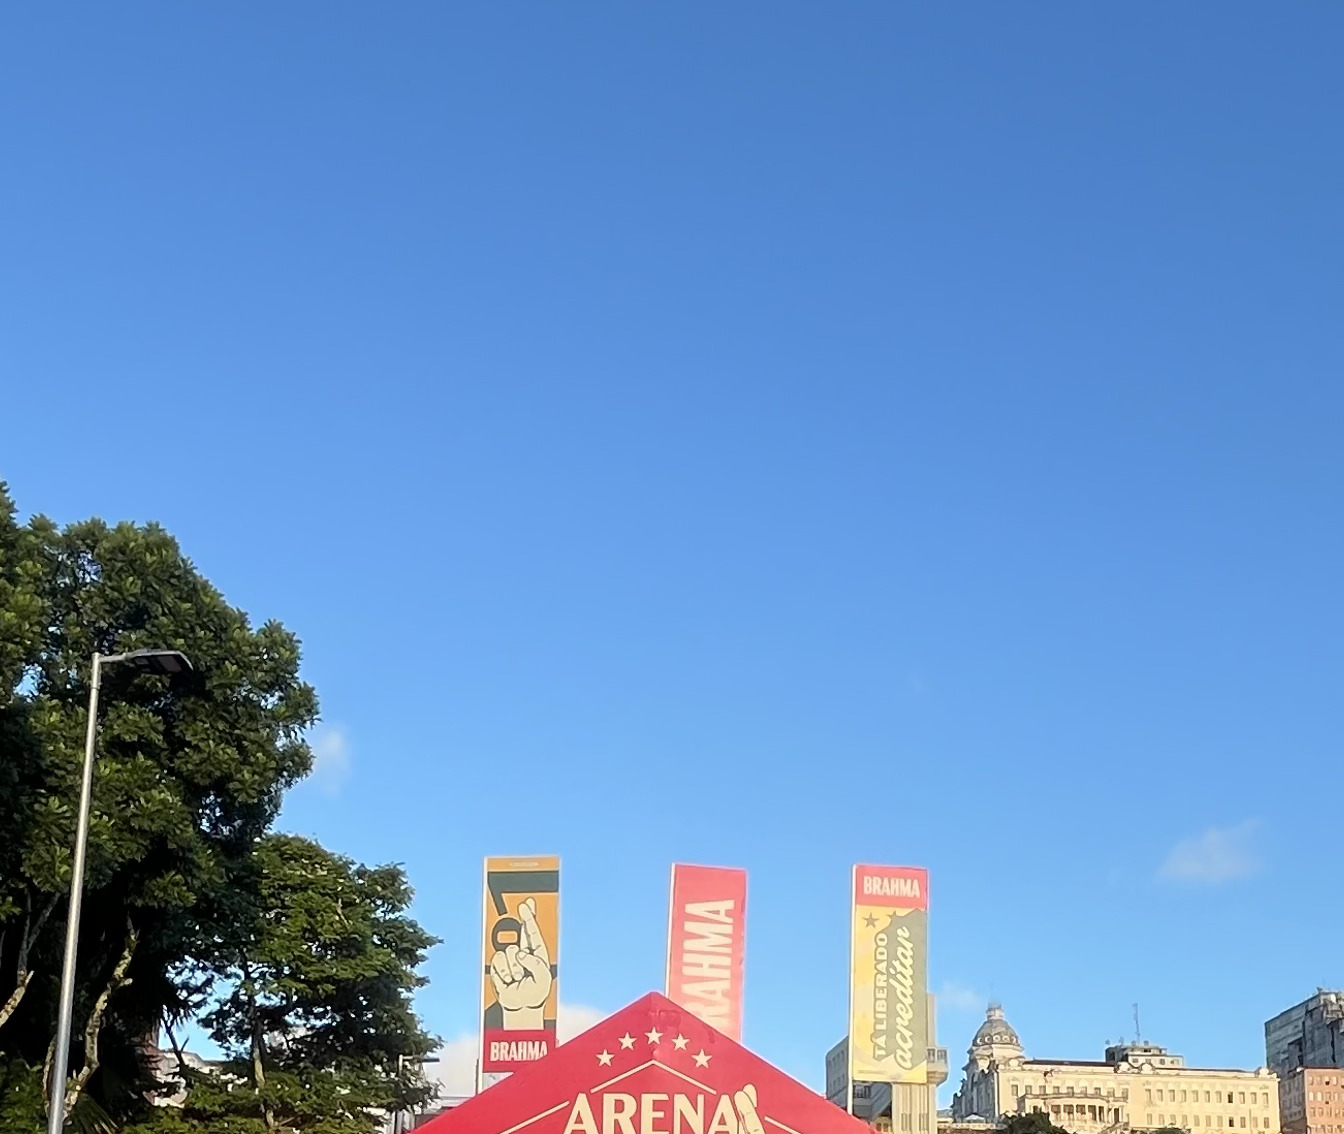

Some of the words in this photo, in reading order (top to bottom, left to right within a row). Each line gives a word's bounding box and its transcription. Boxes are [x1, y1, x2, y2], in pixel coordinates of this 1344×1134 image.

[863, 875, 920, 898] BRAHMA
[681, 899, 735, 1027] RAHMA
[875, 932, 888, 1030] LIBERADO
[889, 926, 914, 1069] acreditar
[490, 1040, 548, 1062] BRAHMA
[872, 1034, 887, 1059] TÁ
